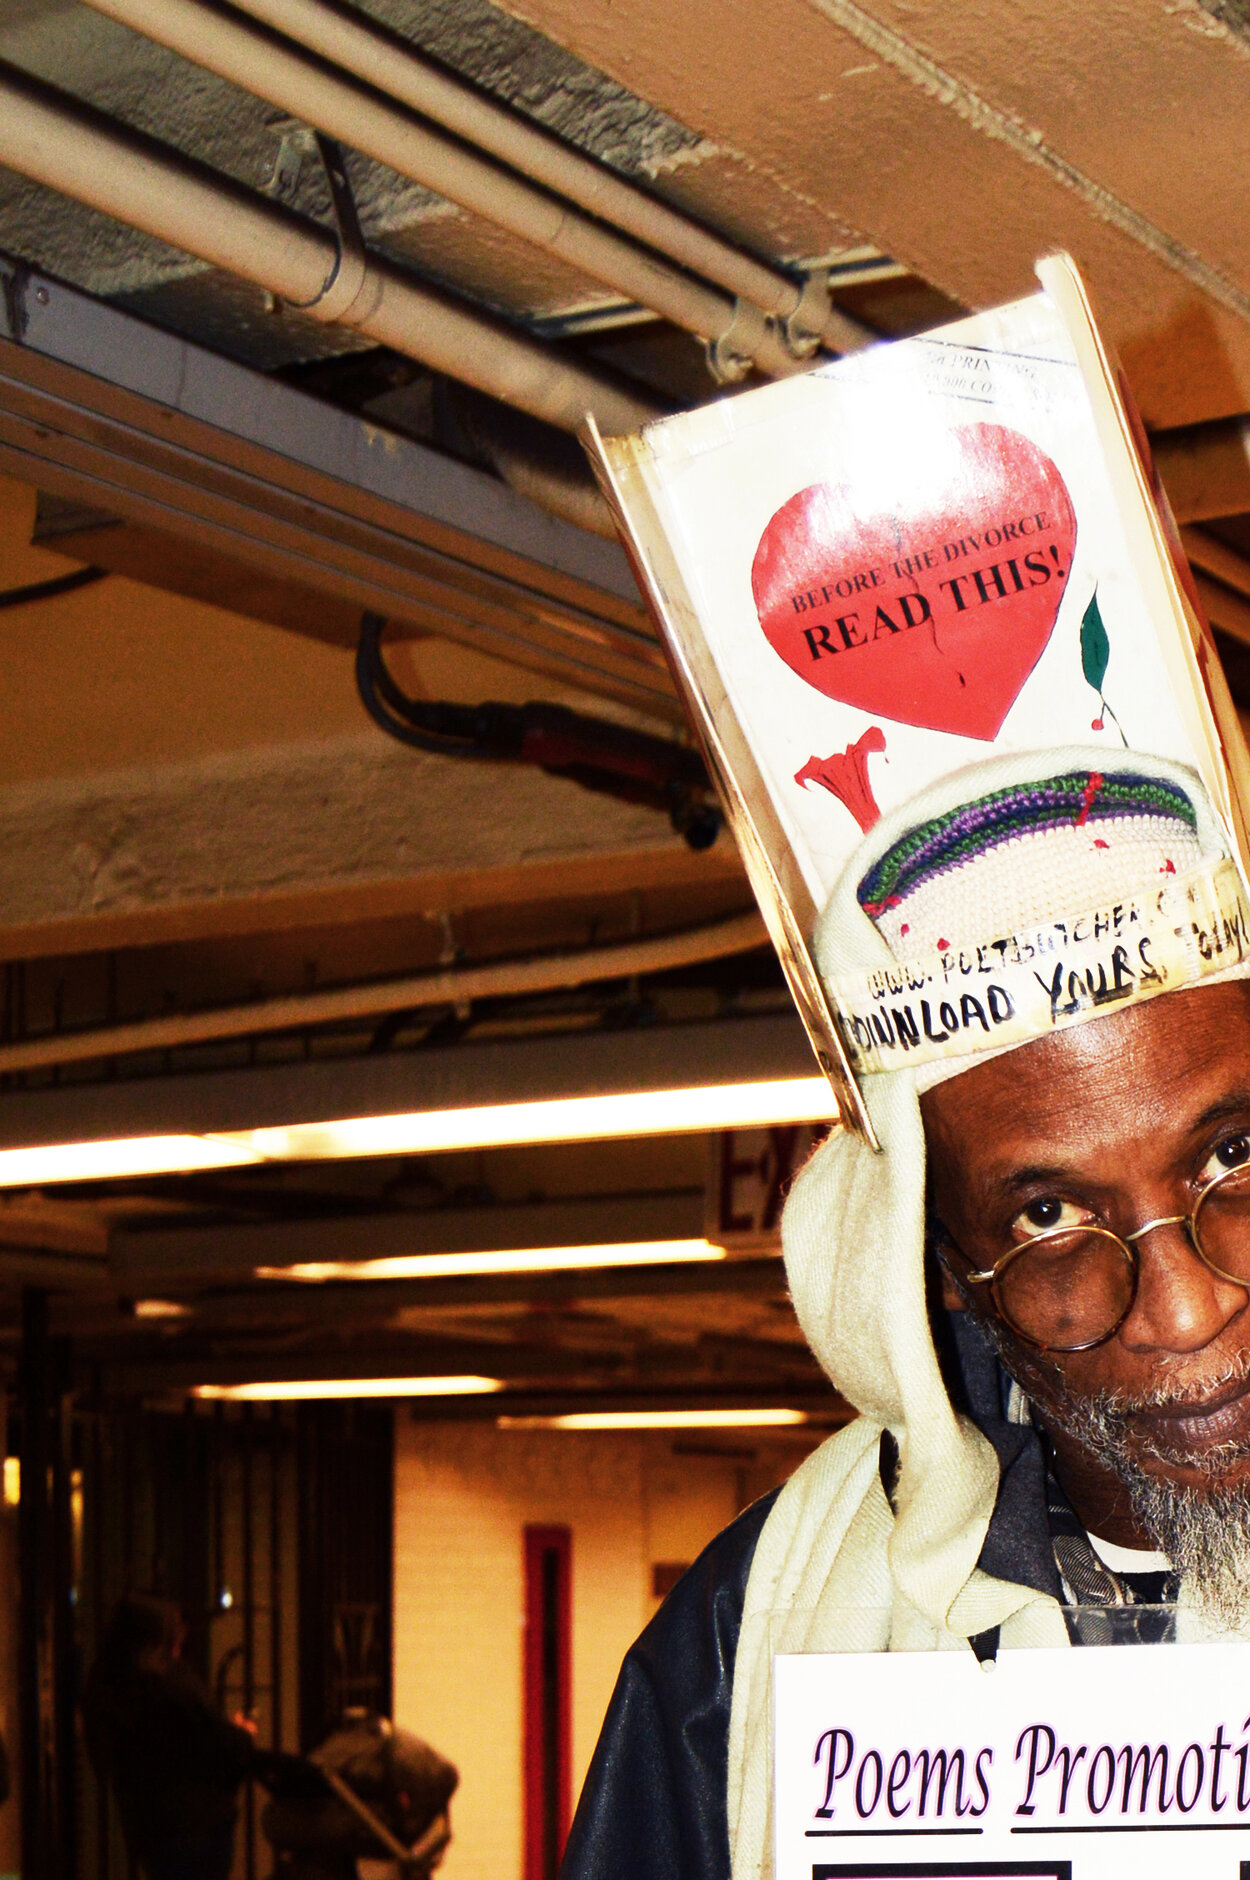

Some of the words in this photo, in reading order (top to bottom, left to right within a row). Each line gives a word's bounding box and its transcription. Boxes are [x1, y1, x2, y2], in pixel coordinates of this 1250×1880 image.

[790, 567, 886, 614] BEFORE
[888, 549, 940, 581] THE
[943, 511, 1052, 563] DIVORCE
[802, 591, 933, 662] READ
[939, 545, 1066, 613] THIS!
[814, 1728, 994, 1819] Poems
